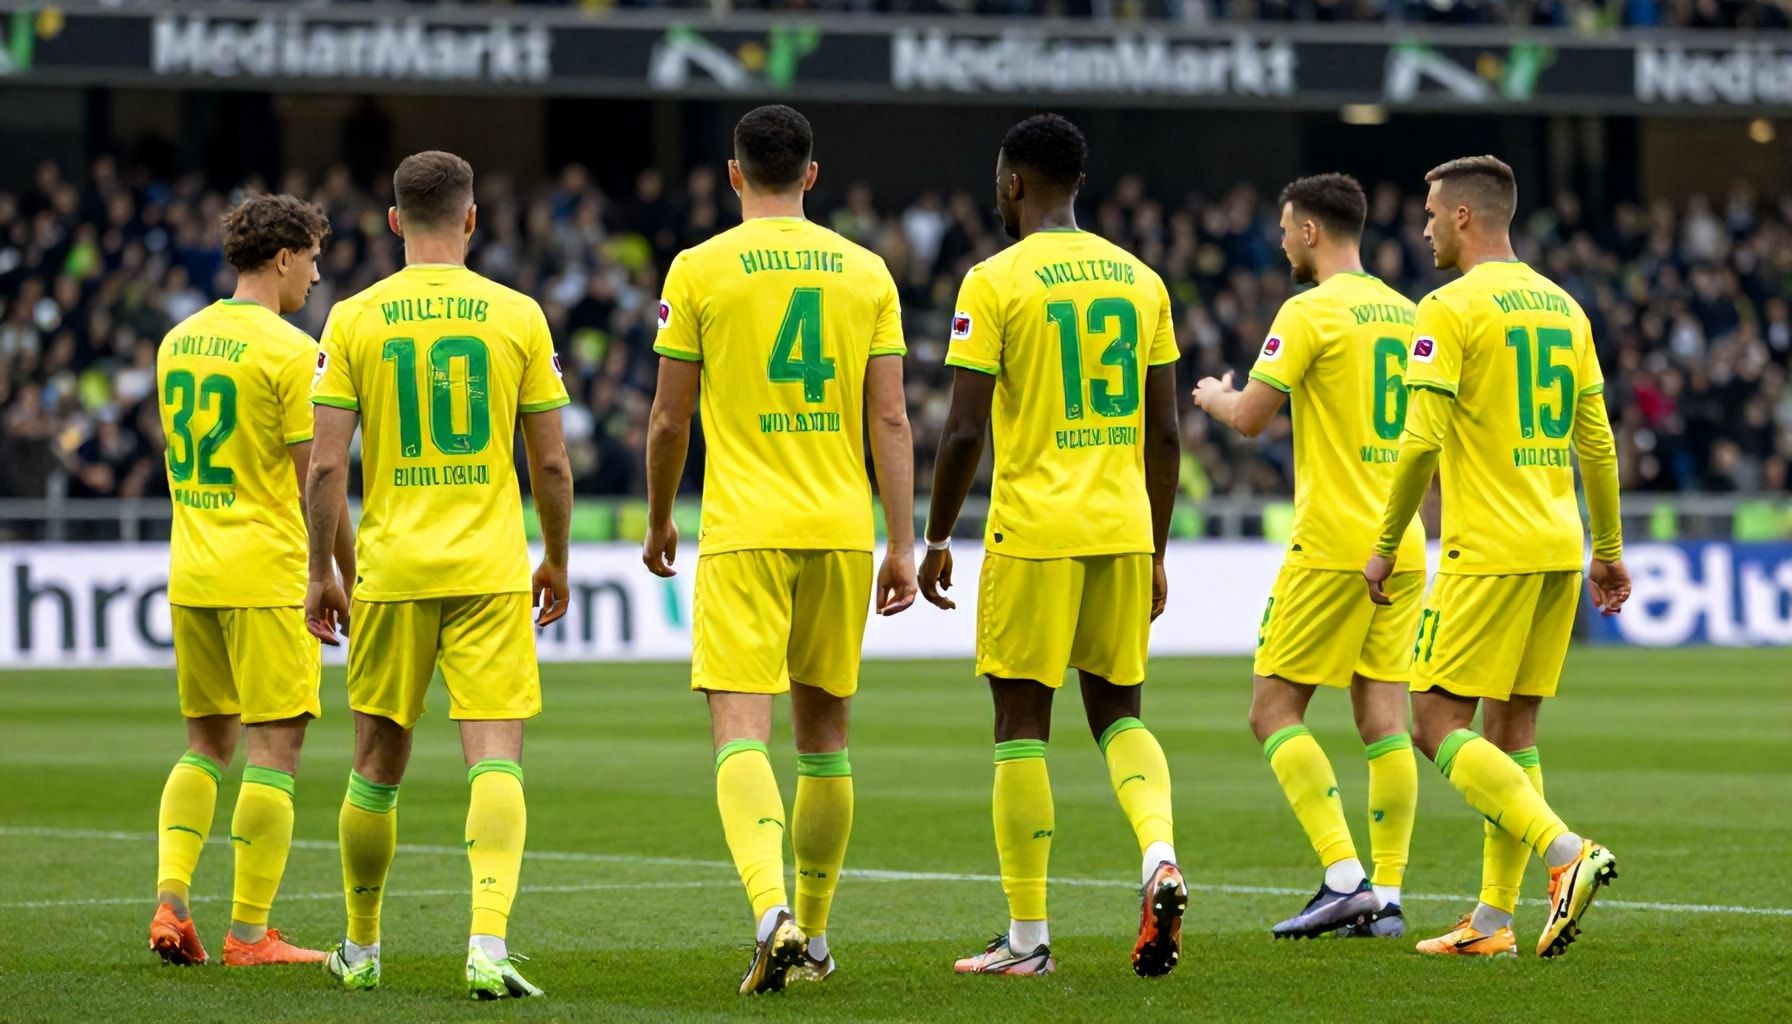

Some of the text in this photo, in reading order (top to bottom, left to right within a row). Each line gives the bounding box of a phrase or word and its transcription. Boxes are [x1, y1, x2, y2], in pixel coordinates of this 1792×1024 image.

[382, 336, 491, 457] 10
[768, 287, 835, 403] 4
[1045, 298, 1140, 420] 13
[1373, 336, 1409, 440] 6
[1506, 326, 1574, 440] 15
[165, 370, 237, 485] 32
